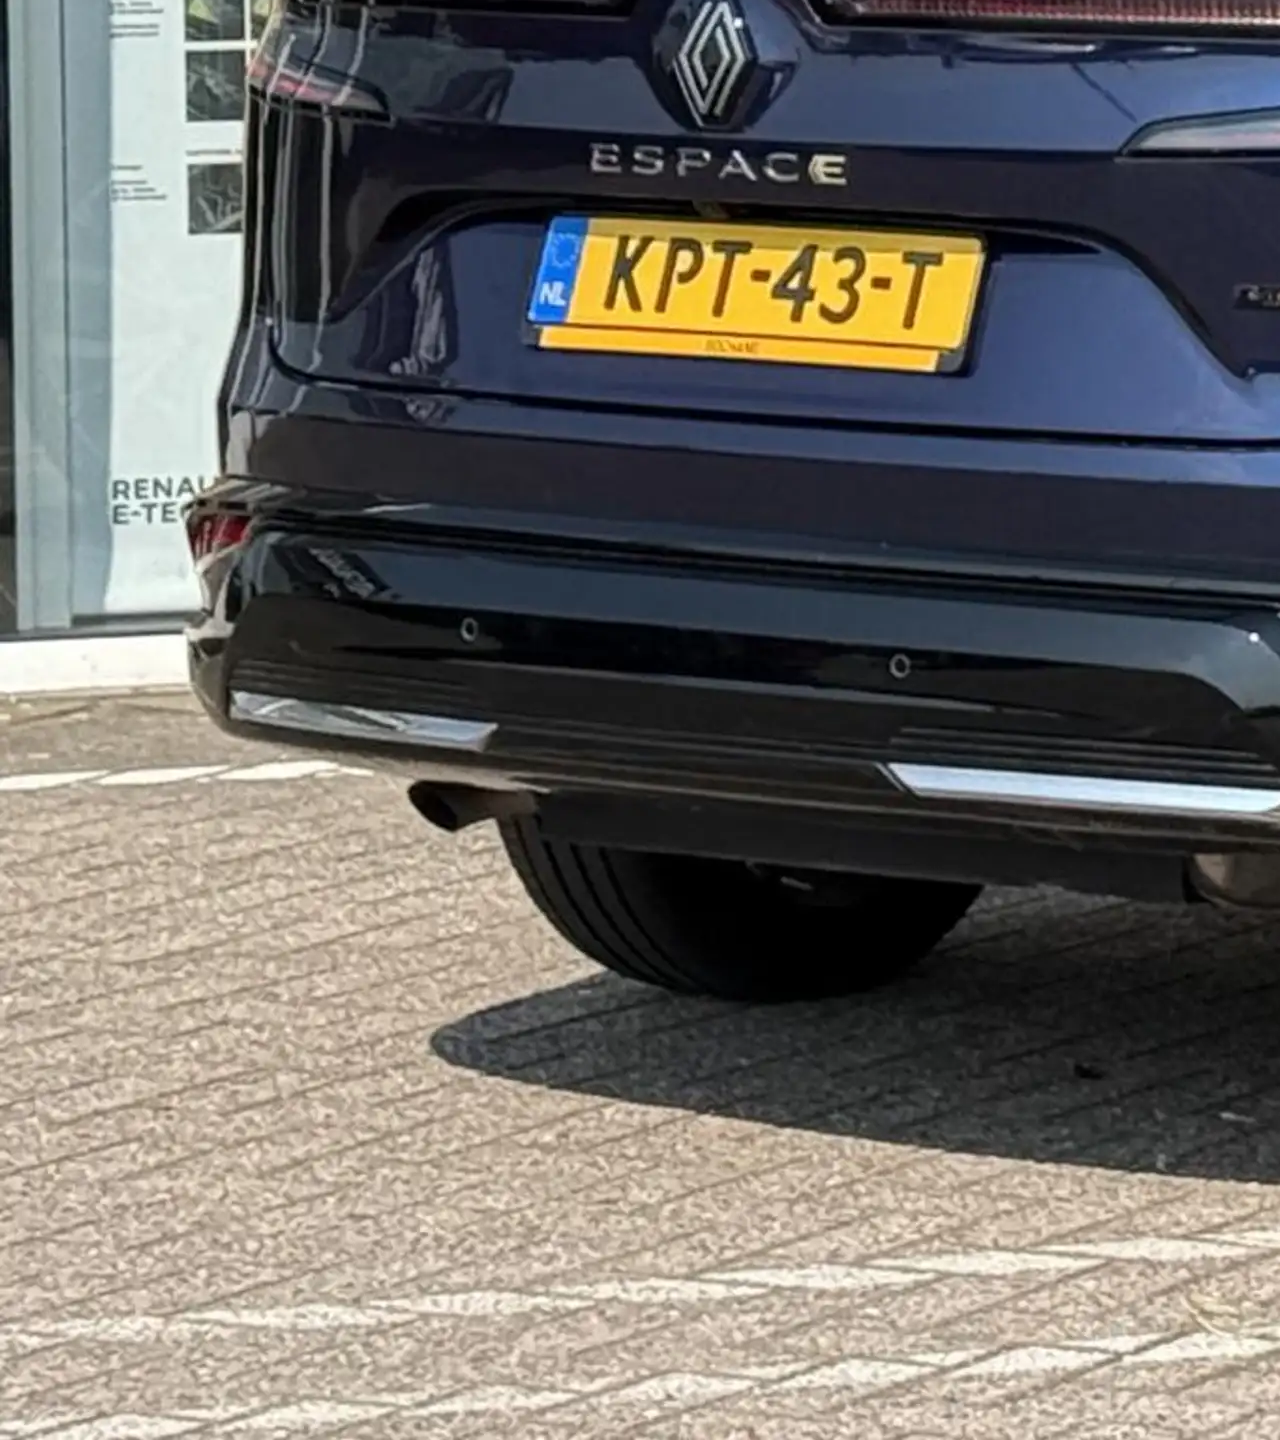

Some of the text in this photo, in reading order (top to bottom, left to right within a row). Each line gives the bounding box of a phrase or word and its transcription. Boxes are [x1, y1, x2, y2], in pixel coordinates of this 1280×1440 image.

[589, 142, 848, 186] ESPACE
[539, 280, 567, 308] NL
[603, 234, 945, 331] KPT-43-T
[111, 502, 186, 525] E-TE
